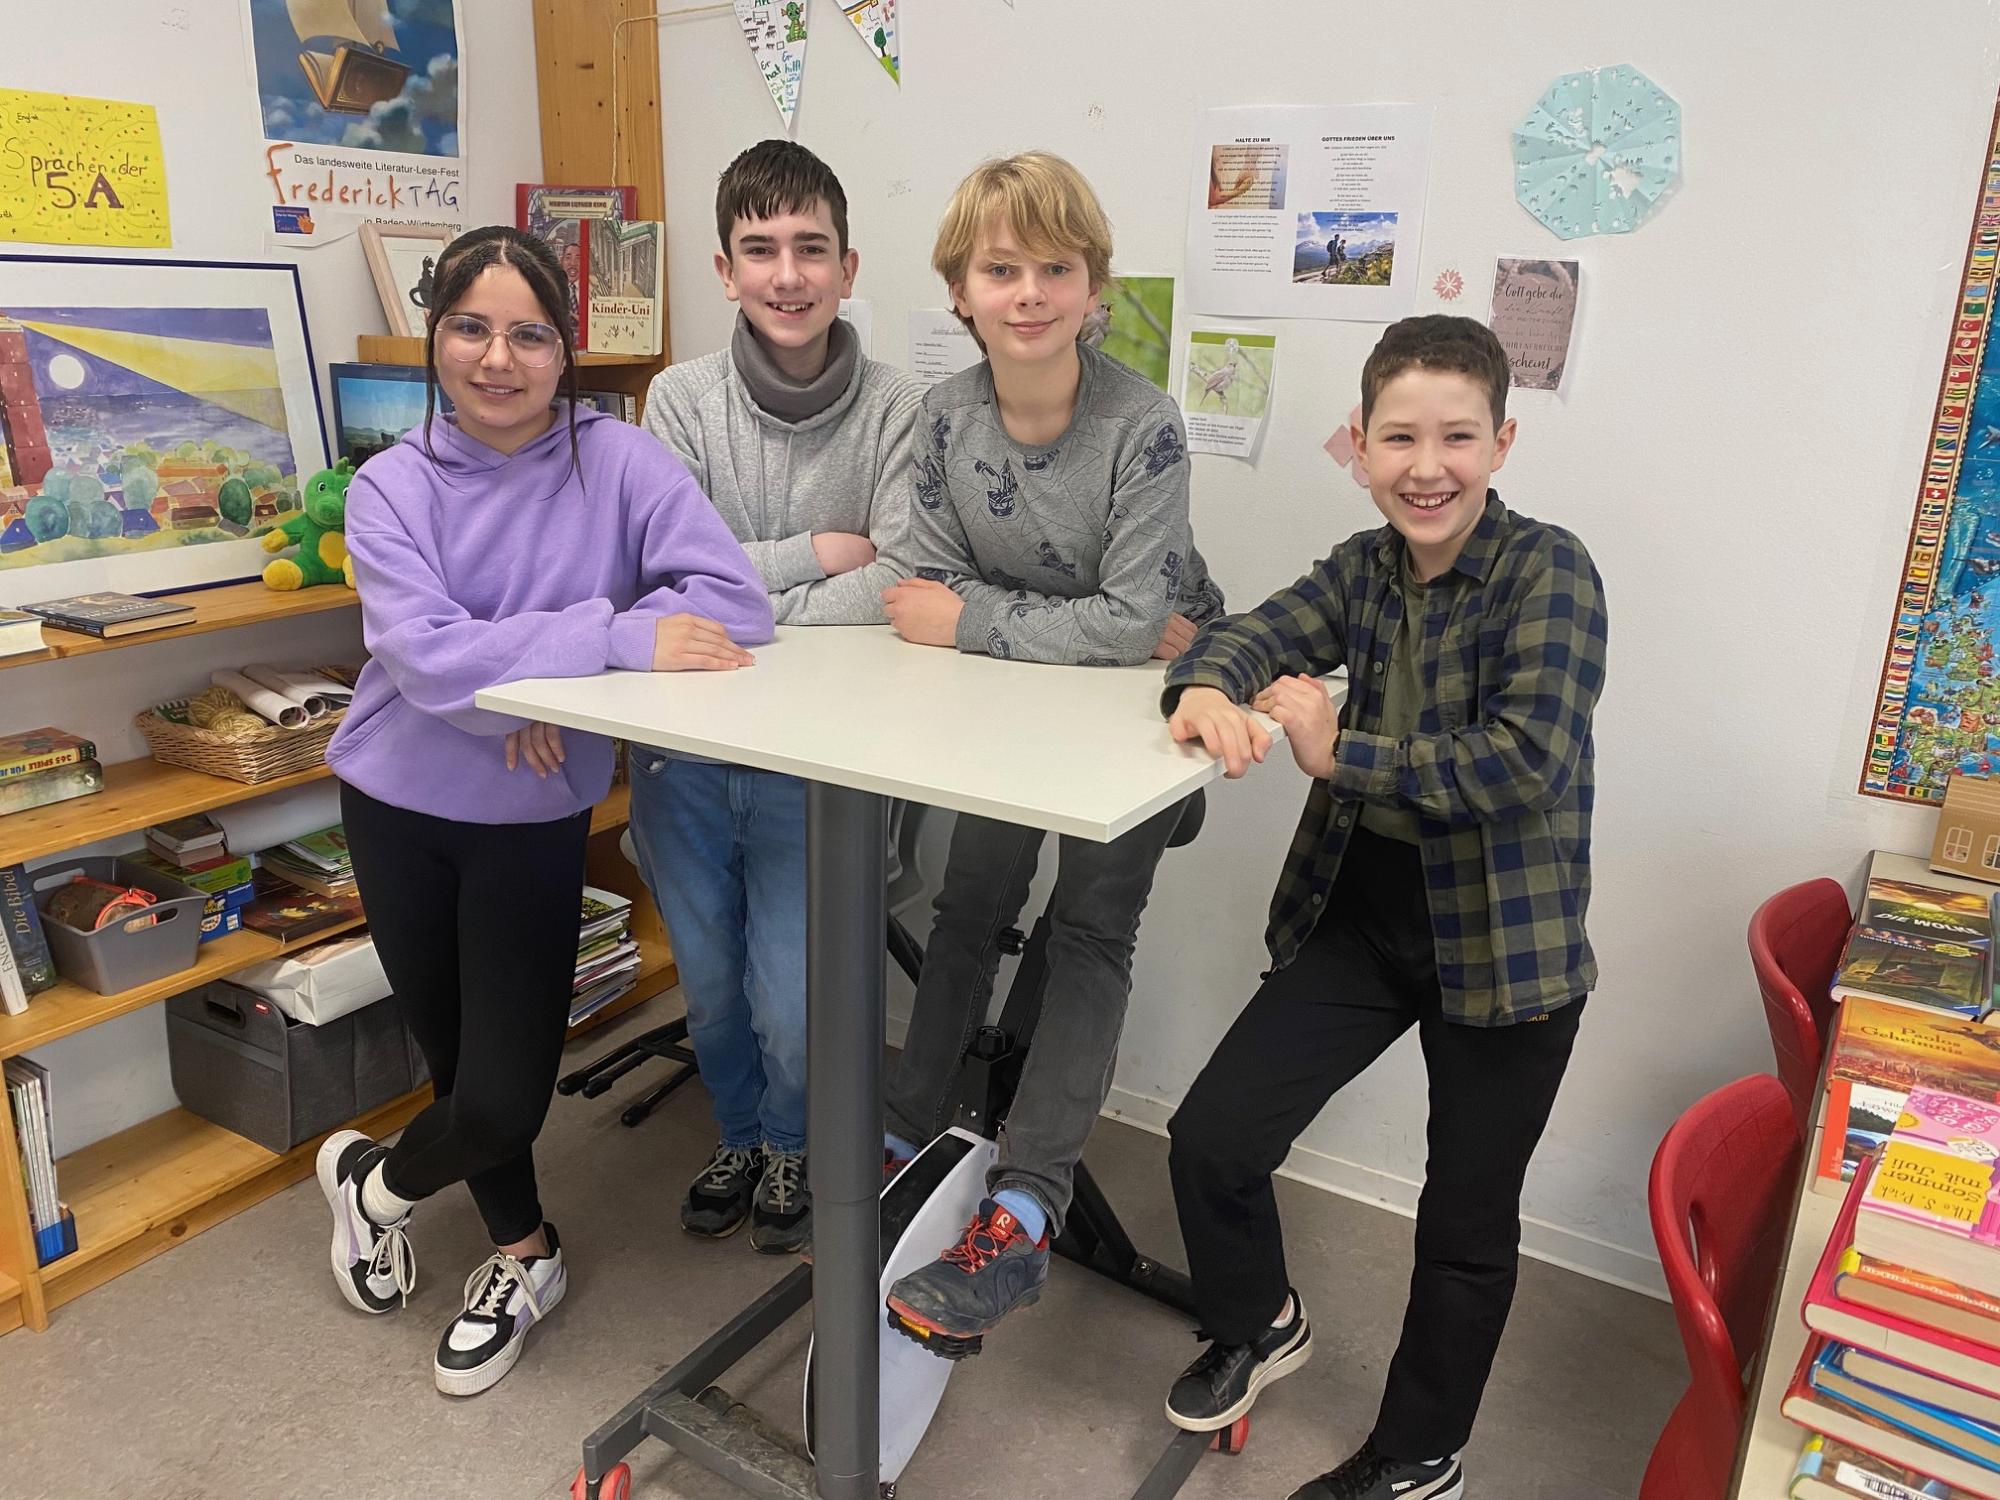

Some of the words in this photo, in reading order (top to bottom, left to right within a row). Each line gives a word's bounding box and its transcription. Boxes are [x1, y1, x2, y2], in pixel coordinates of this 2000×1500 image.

[5, 136, 107, 187] Sprachen
[118, 152, 148, 178] der
[294, 154, 314, 166] Das
[316, 157, 373, 171] landesweite
[375, 162, 460, 178] Literatur-Lese-Fest
[1505, 283, 1525, 298] Gott
[1525, 285, 1547, 304] gebe
[1549, 287, 1563, 299] dir
[592, 303, 650, 316] Kinder-Uni
[28, 758, 54, 771] SPIELE
[55, 754, 72, 764] 365
[4, 870, 24, 907] Bibel
[13, 910, 32, 935] Die
[1874, 912, 1911, 923] DIE
[1913, 919, 1985, 937] WOLKE
[1860, 1025, 1963, 1055] Geheimnis
[1901, 1026, 1962, 1048] Paolos
[1891, 1158, 1935, 1177] Juli
[1882, 1170, 1982, 1203] Sommer
[1943, 1172, 1982, 1189] mit
